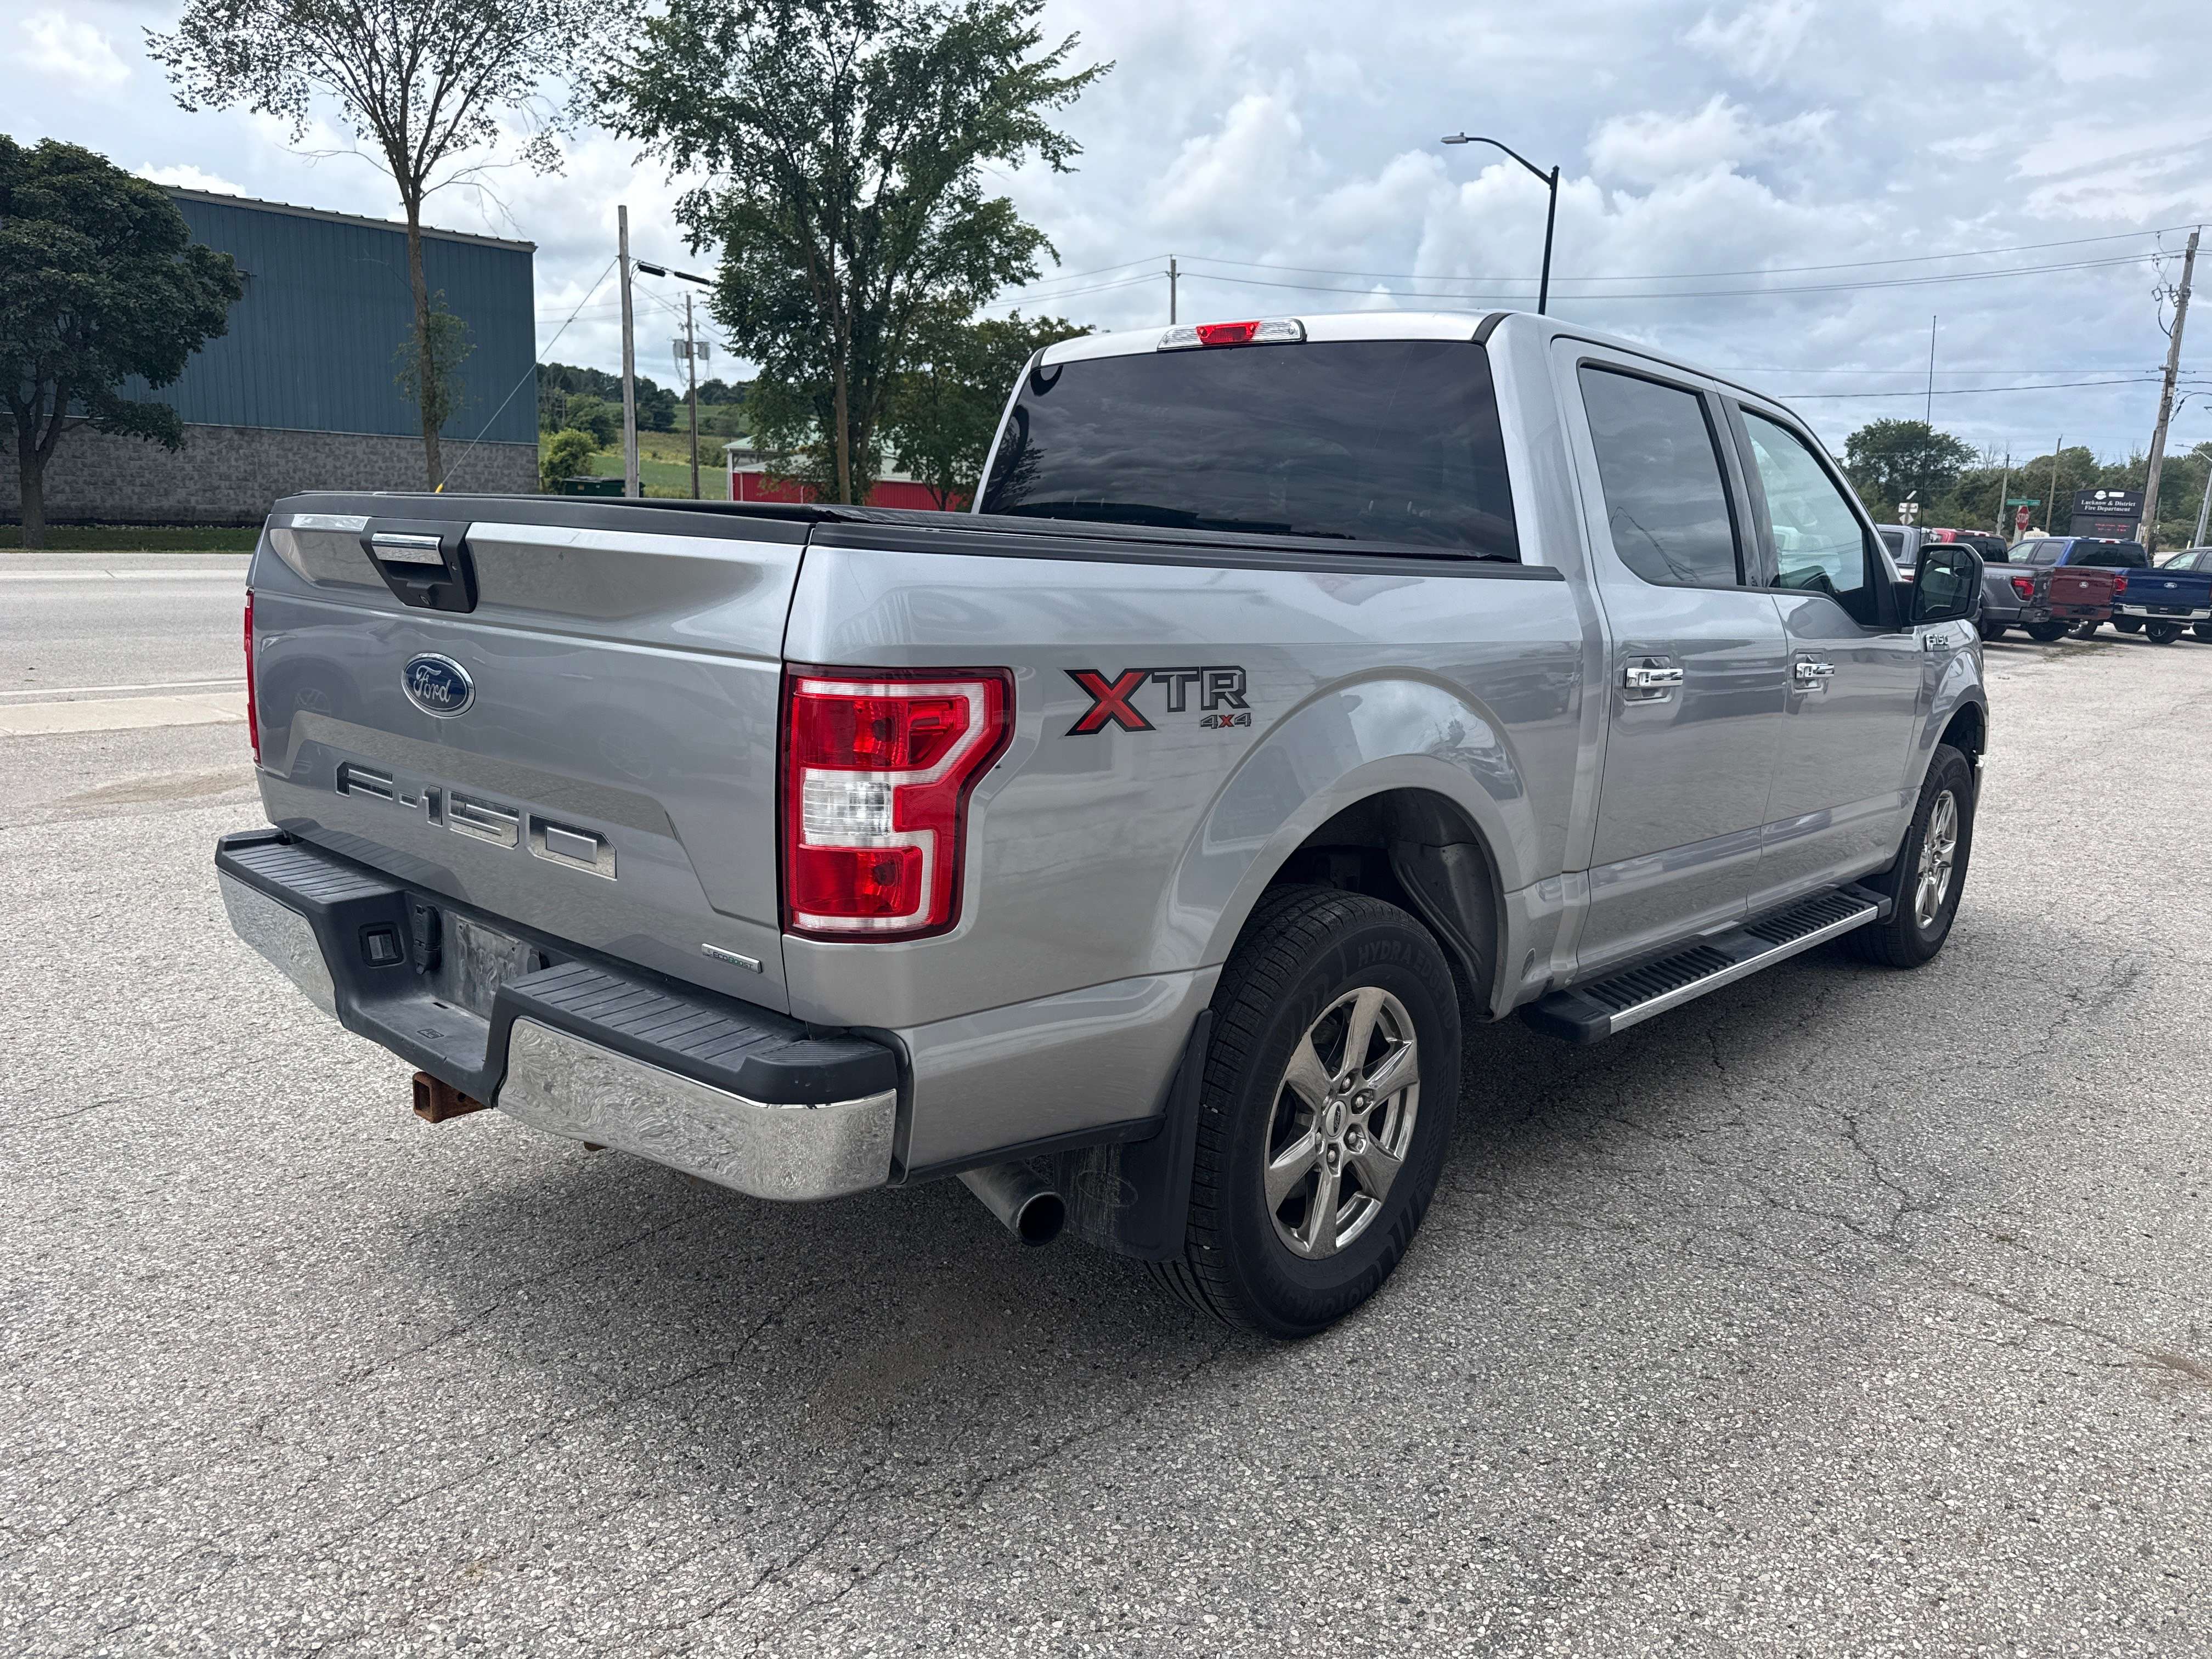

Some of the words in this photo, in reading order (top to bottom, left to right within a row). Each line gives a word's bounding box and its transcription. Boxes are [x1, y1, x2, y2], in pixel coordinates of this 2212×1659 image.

[2017, 513, 2029, 523] STOP
[413, 665, 452, 703] Ford
[1063, 665, 1251, 737] XTR
[336, 759, 618, 882] F-150
[713, 951, 753, 971] ECOBOOST
[1358, 940, 1412, 967] HYDRA
